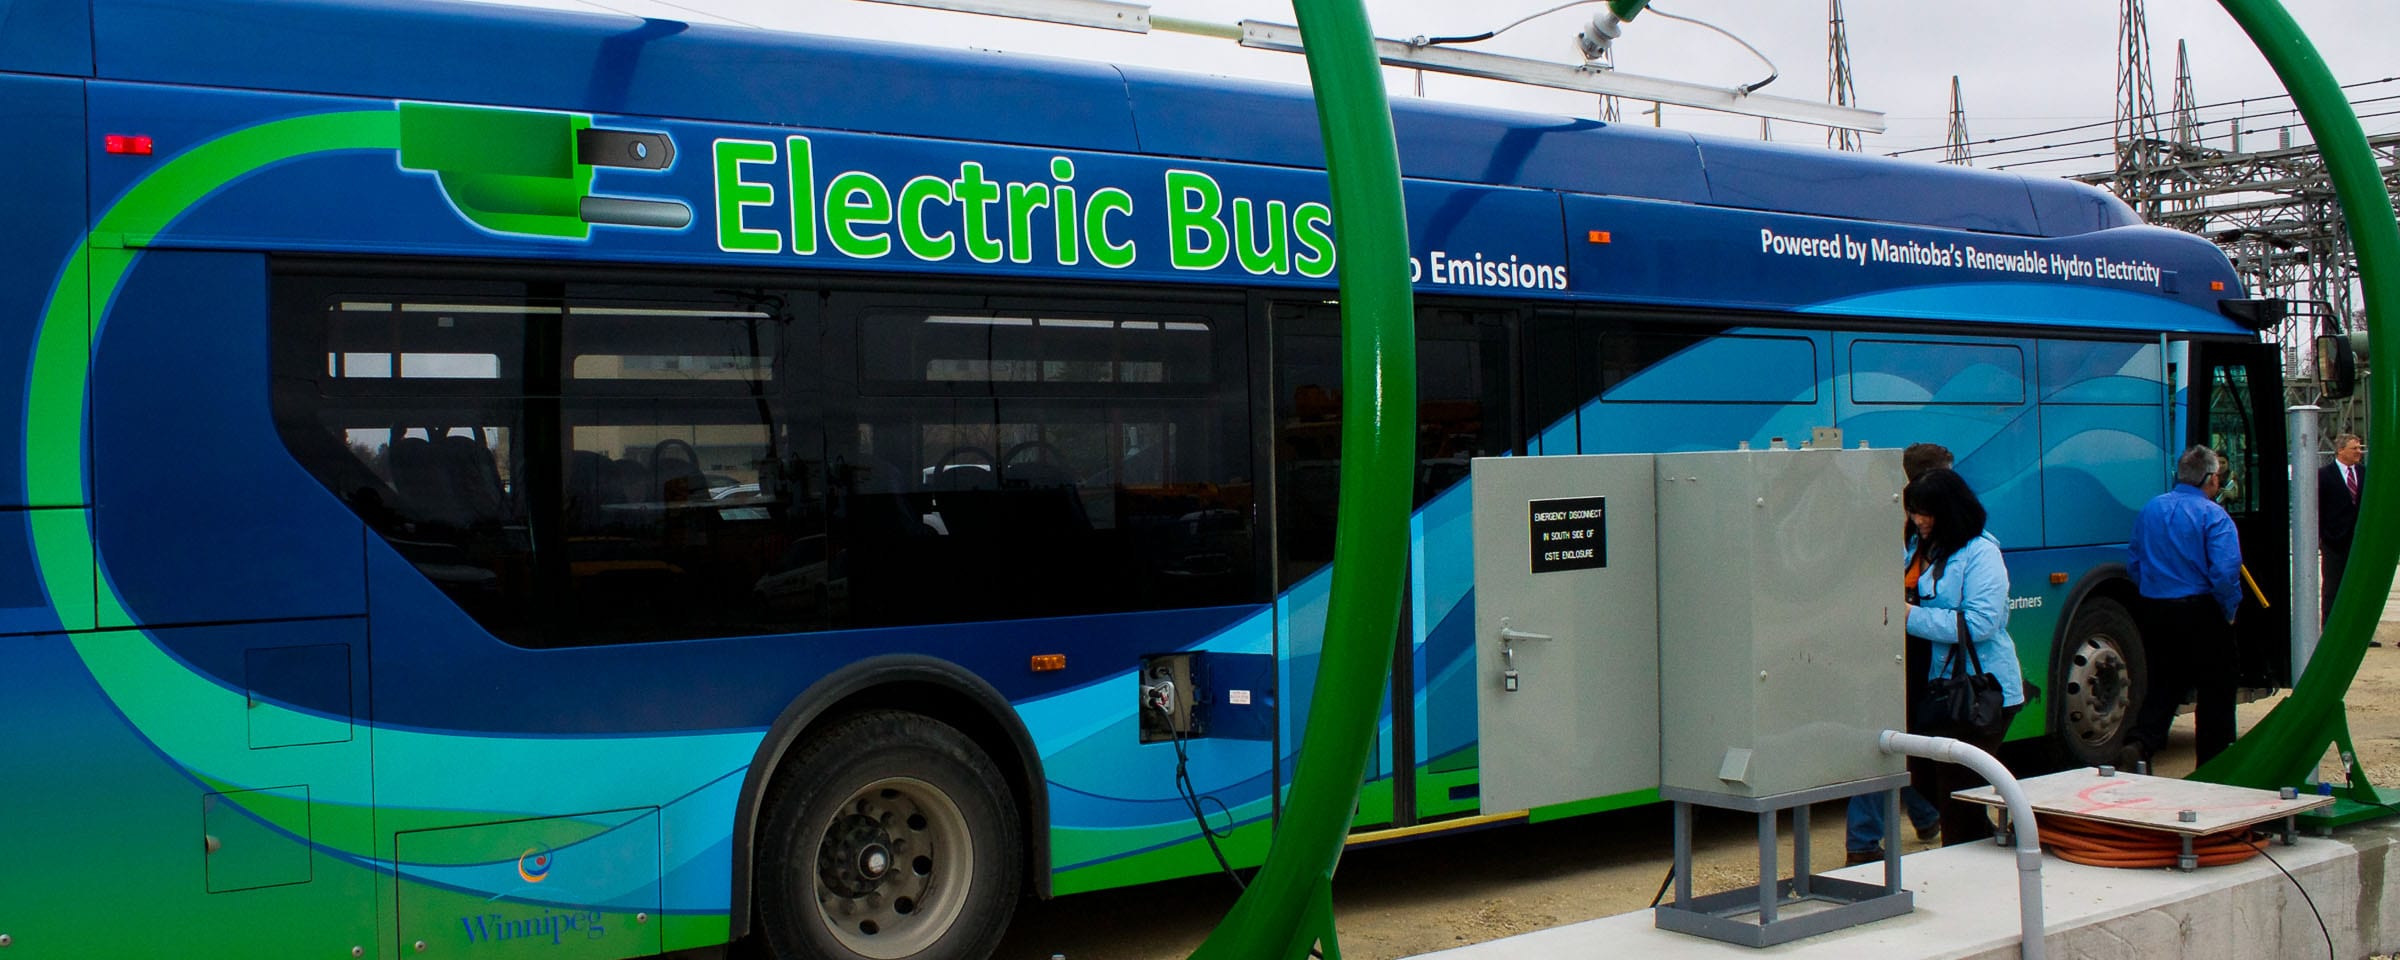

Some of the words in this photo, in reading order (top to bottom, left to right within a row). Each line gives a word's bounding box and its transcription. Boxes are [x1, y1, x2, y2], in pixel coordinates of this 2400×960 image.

[713, 135, 1136, 269] Electric
[1165, 169, 1336, 278] Bus
[1761, 228, 1841, 259] Powered
[1845, 234, 1867, 266] by
[1871, 238, 1963, 268] Manitoba's
[1965, 246, 2048, 274] Renewable
[2050, 253, 2093, 281] Hydro
[2095, 257, 2161, 287] Electricity
[1430, 251, 1568, 290] Emissions
[1534, 511, 1567, 522] EMERGENCY
[1568, 509, 1602, 520] DISCONNECT
[1551, 531, 1570, 541] SOUTH
[1572, 530, 1585, 539] SIDE
[1586, 529, 1595, 538] OF
[1562, 549, 1595, 560] ENCLOSURE
[2008, 596, 2042, 610] artners
[461, 909, 605, 945] Winnipeg
